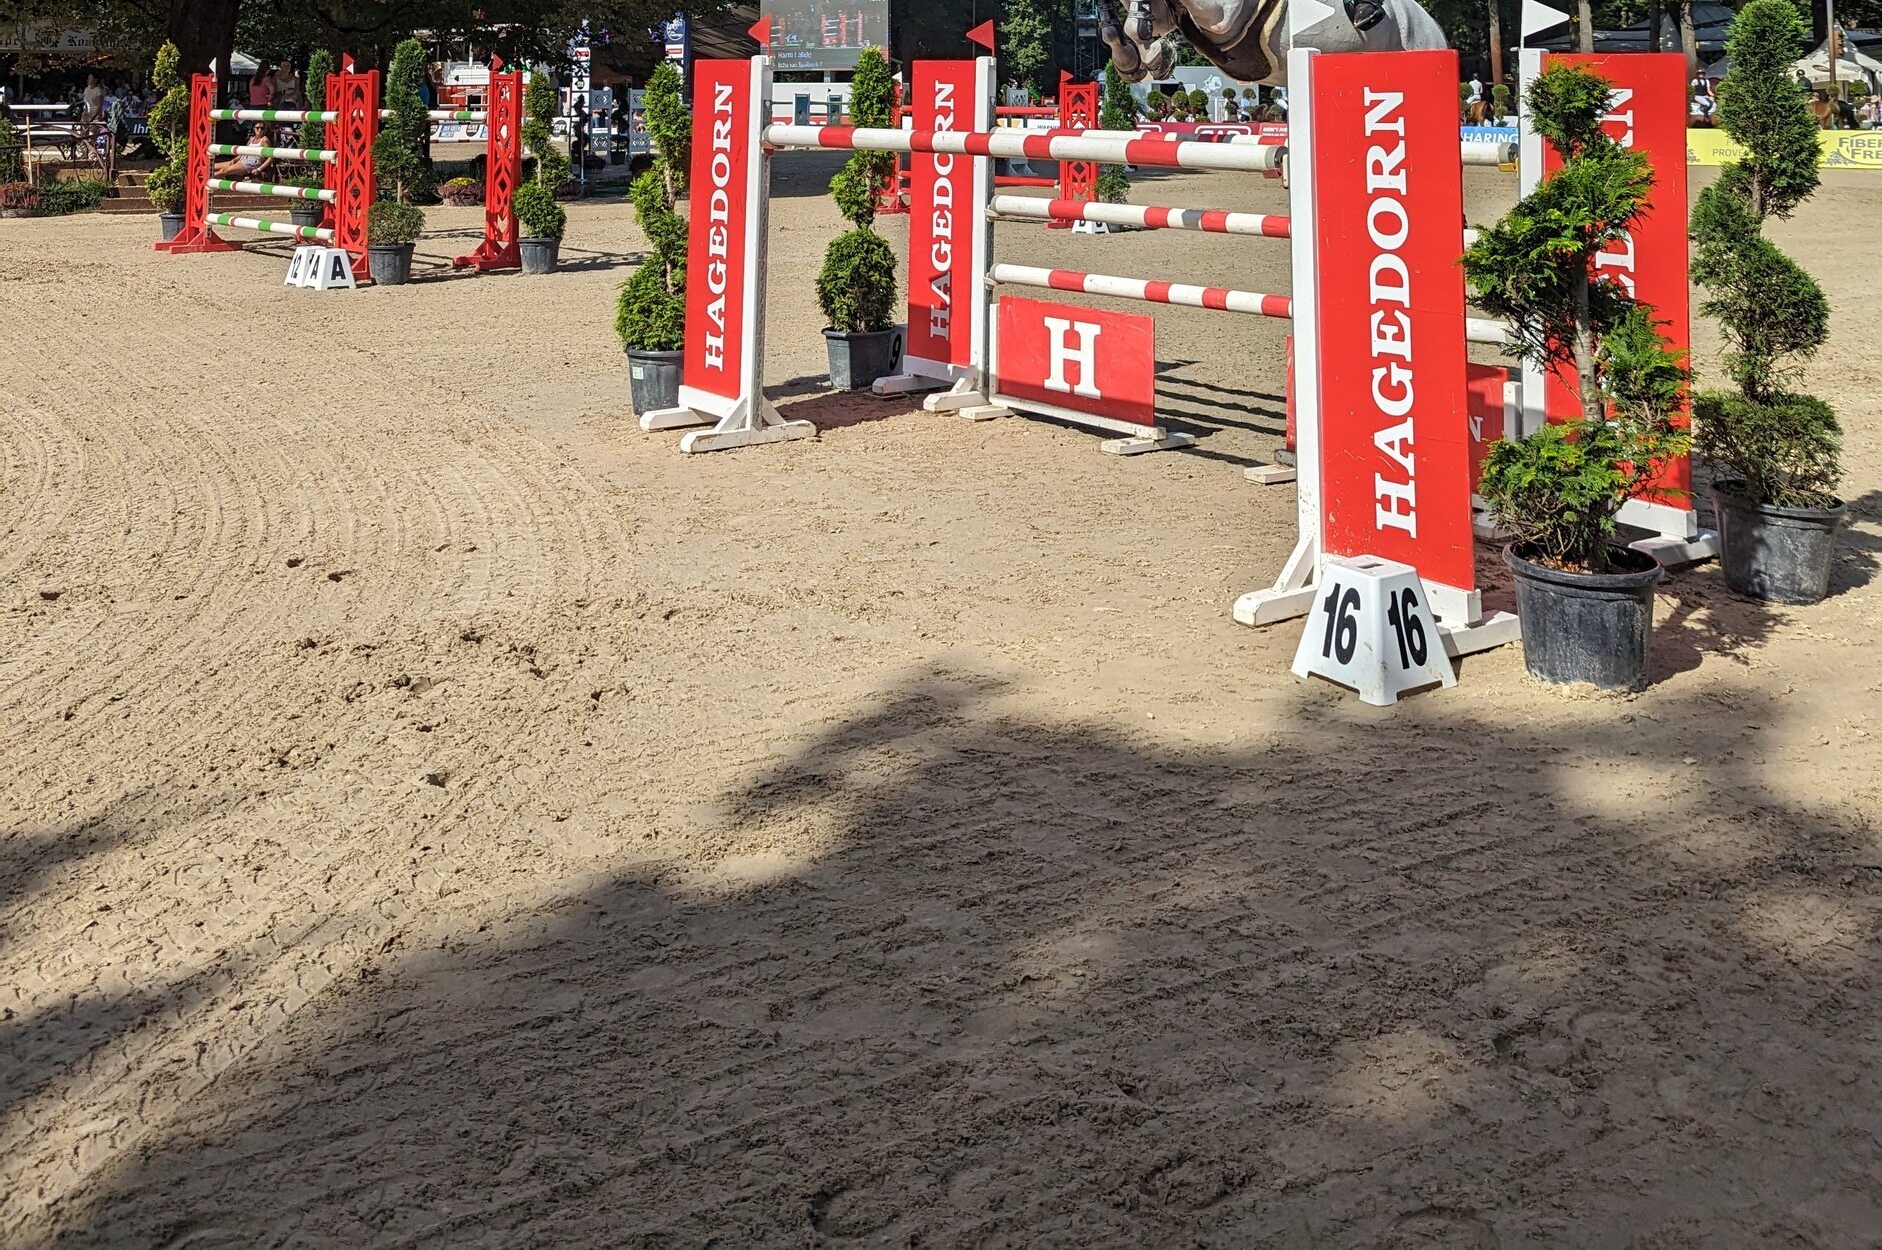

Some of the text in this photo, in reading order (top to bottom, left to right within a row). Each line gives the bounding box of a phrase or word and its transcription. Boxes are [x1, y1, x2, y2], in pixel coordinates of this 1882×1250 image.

[1460, 132, 1519, 144] HARING
[330, 255, 347, 281] A
[705, 81, 733, 372] HAGEDORN
[1363, 85, 1417, 539] HAGEDORN
[1043, 316, 1102, 400] H
[1322, 582, 1361, 666] 16
[1387, 587, 1428, 670] 16
